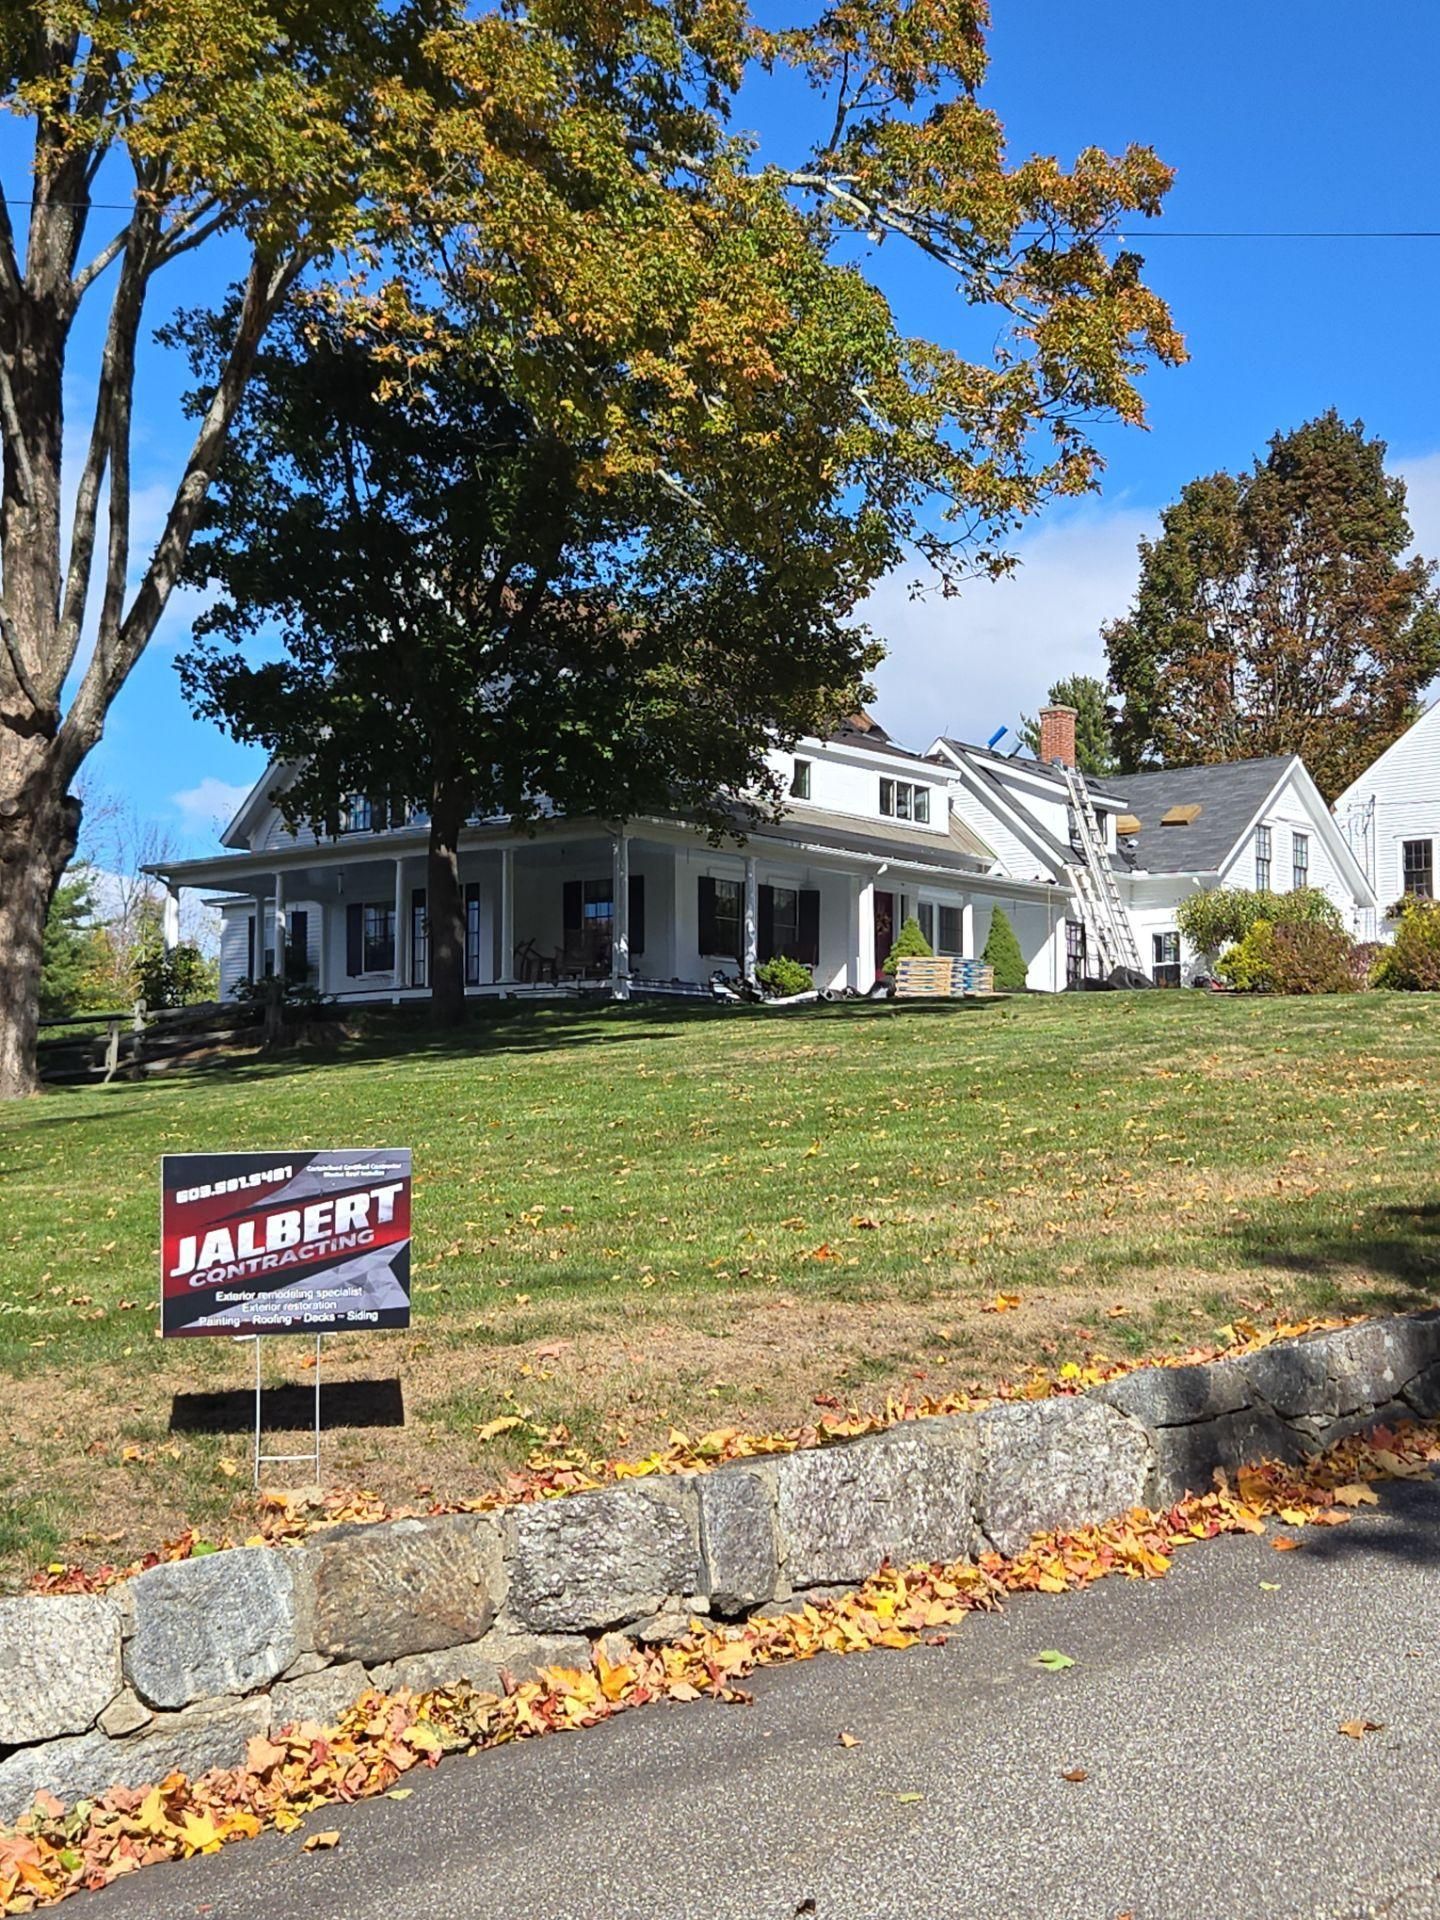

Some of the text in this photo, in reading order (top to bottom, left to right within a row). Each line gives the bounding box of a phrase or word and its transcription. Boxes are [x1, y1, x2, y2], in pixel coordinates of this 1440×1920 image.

[170, 1182, 403, 1277] JALBERT
[189, 1229, 374, 1287] CONTRACTING
[215, 1287, 363, 1302] Exterior remodeling specialist
[242, 1300, 337, 1313] Exterior restoration
[199, 1316, 240, 1328] Painting
[252, 1314, 292, 1326] Roofing
[303, 1312, 336, 1322] Decks
[347, 1310, 379, 1322] Siding
